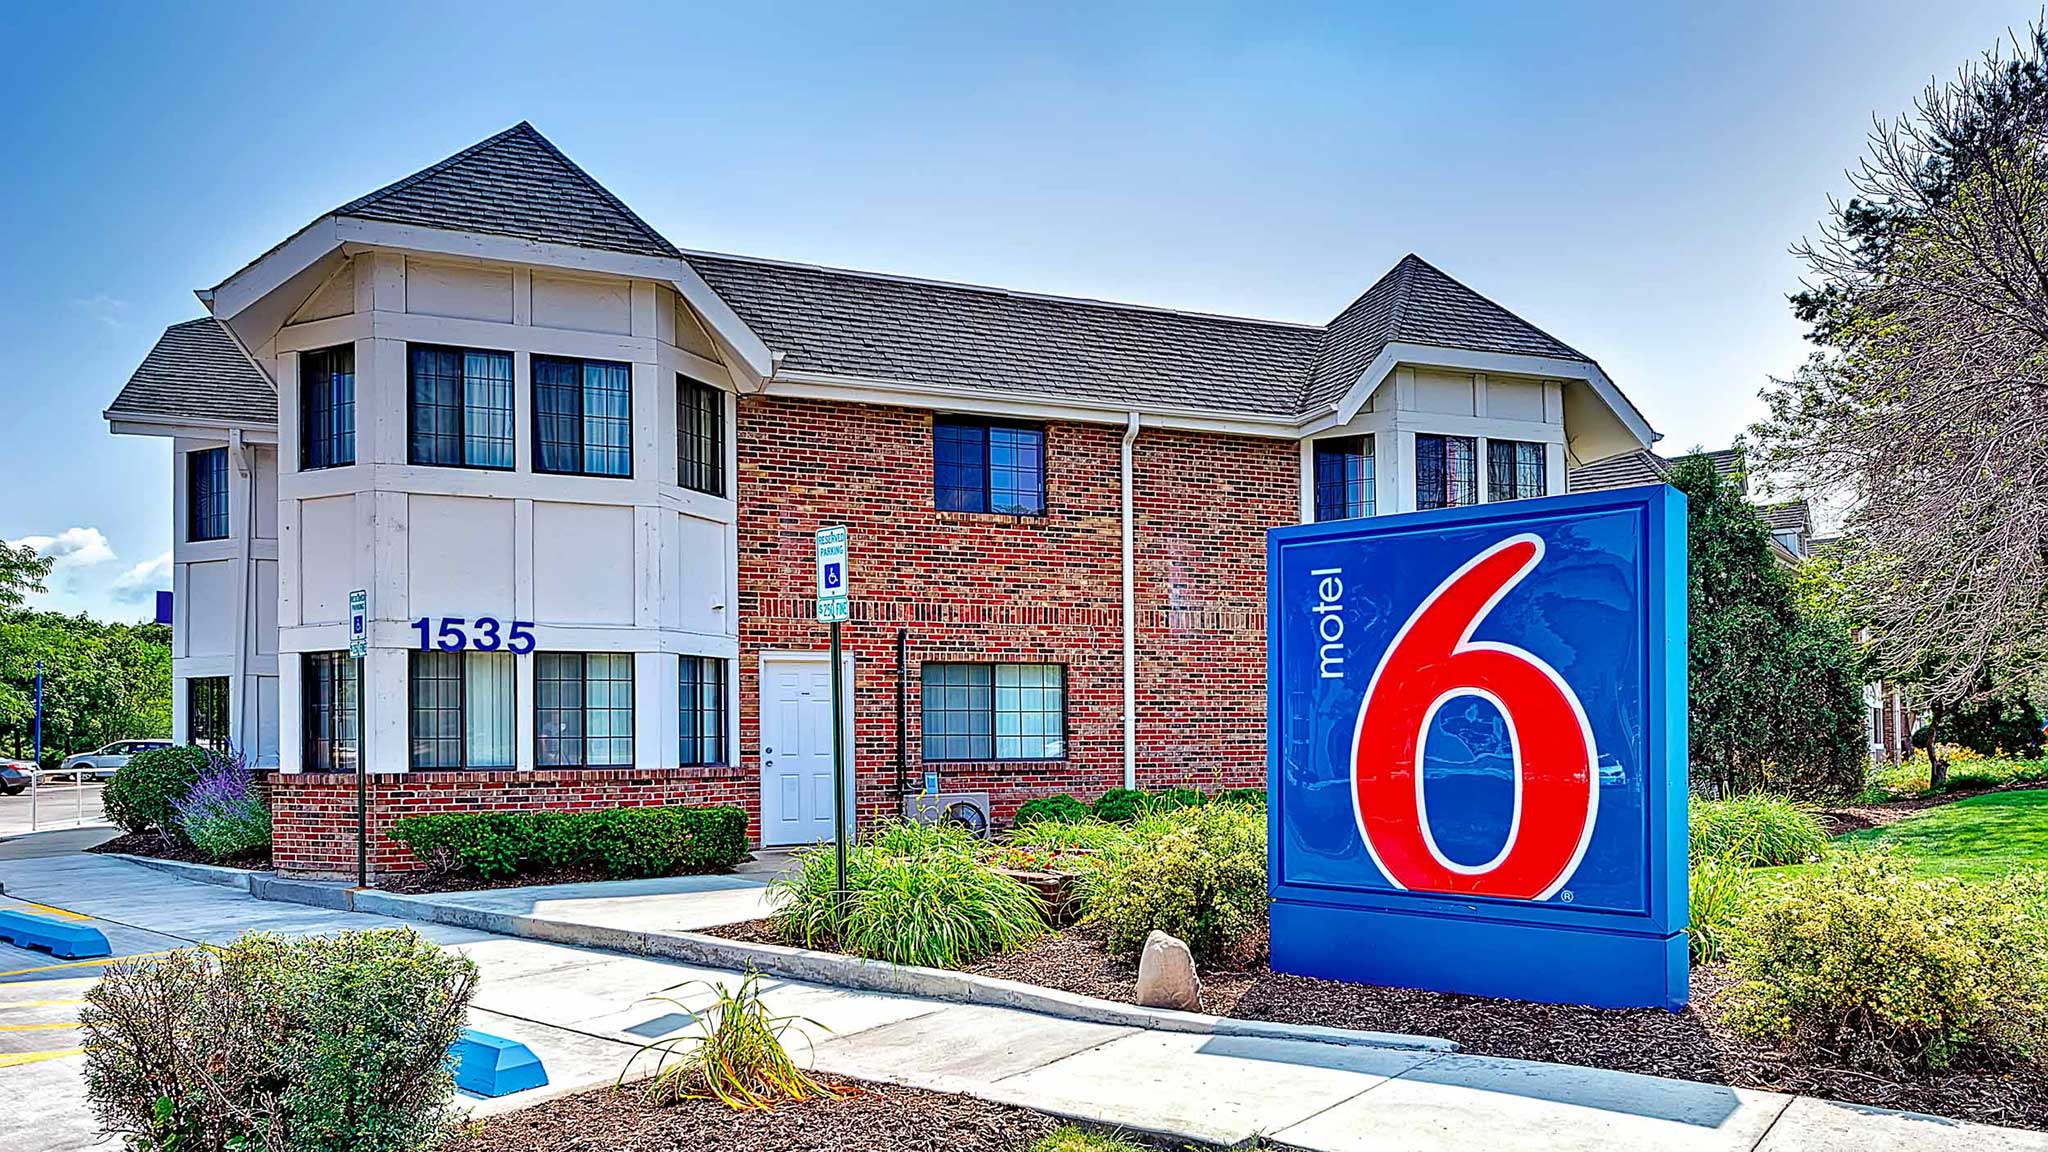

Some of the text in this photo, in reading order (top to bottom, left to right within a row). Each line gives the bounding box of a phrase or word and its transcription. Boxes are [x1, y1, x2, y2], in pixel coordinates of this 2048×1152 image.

[818, 533, 844, 545] RESERVED
[820, 545, 843, 557] PARKING
[818, 602, 848, 617] $250 FINE
[411, 617, 536, 655] 1535
[1311, 567, 1344, 679] motel
[1350, 533, 1600, 901] 6
